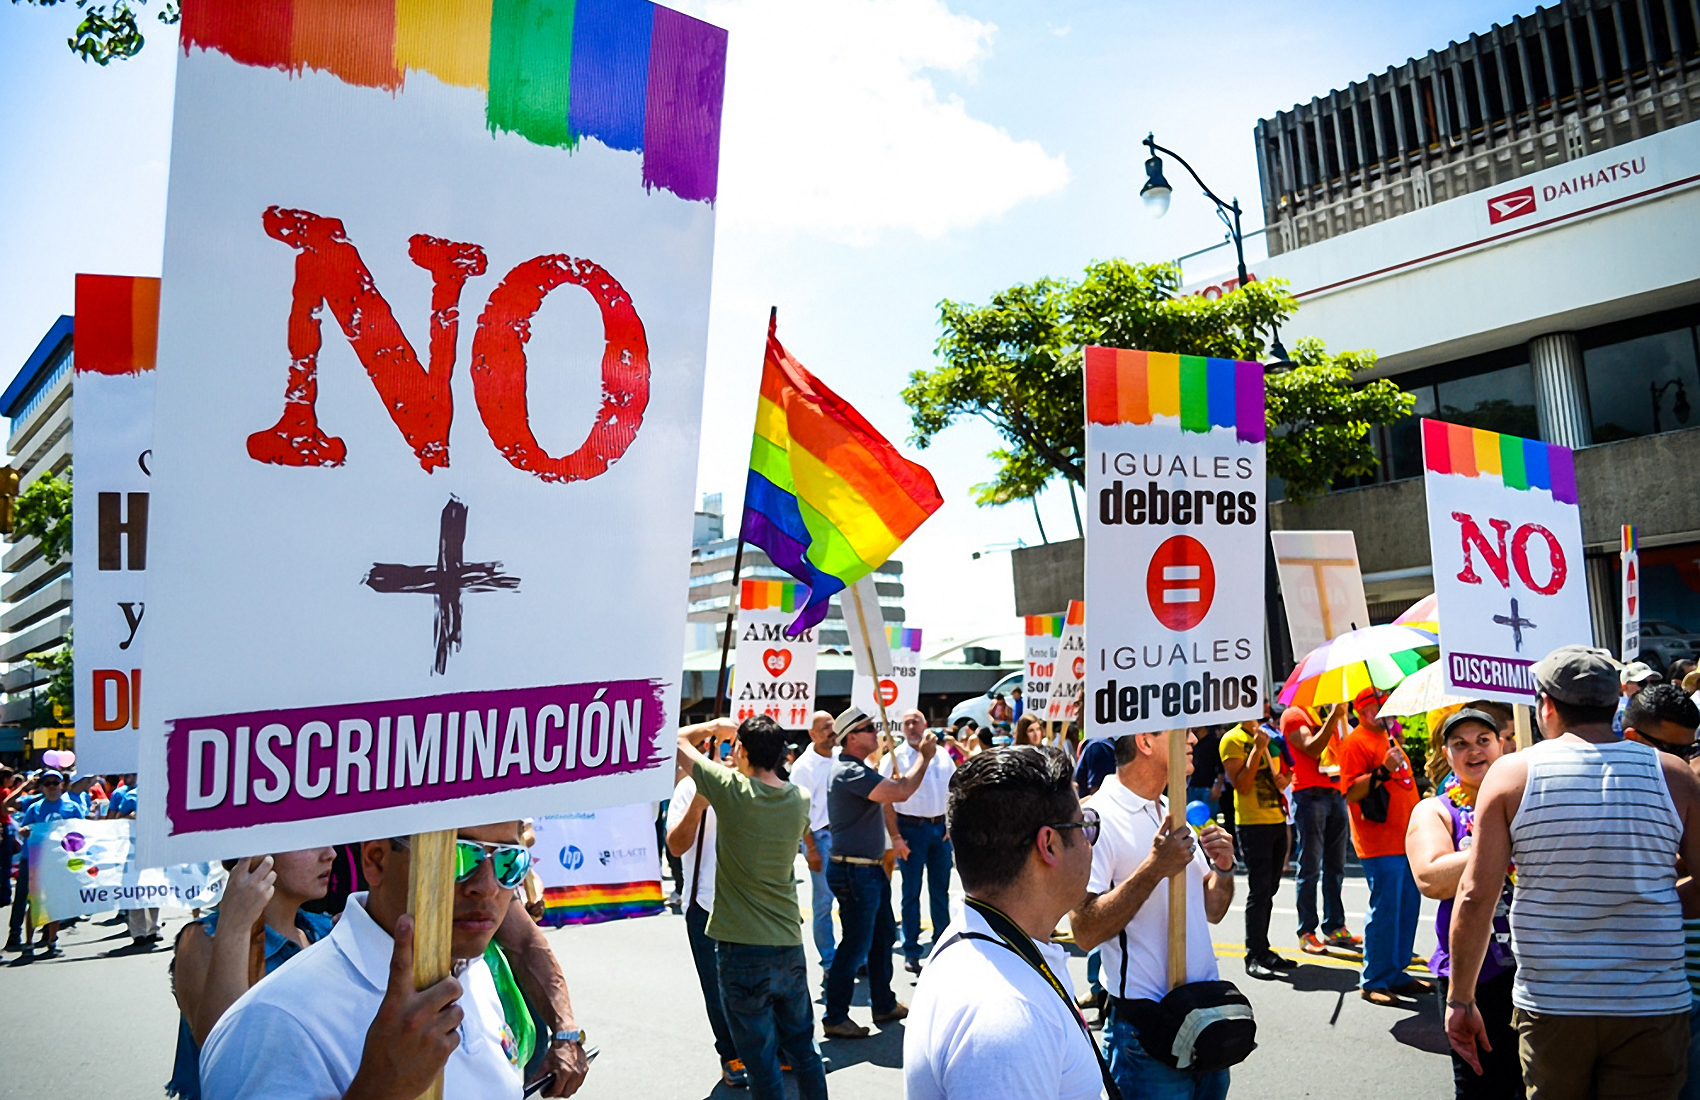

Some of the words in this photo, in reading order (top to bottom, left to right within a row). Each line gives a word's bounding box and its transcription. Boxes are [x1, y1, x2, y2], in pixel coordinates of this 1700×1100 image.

[1543, 157, 1647, 202] DAIHATSU
[246, 204, 651, 484] NO
[1101, 452, 1252, 480] IGUALES
[1099, 480, 1257, 525] deberes
[1451, 511, 1568, 596] NO
[742, 622, 814, 642] AMOR
[767, 655, 785, 670] es
[1100, 638, 1252, 671] IGUALES
[738, 681, 810, 700] AMOR
[1095, 672, 1258, 725] derechos
[185, 688, 643, 811] DISCRIMINACIÓN
[560, 845, 583, 870] hp
[80, 888, 108, 904] We
[113, 884, 181, 900] support
